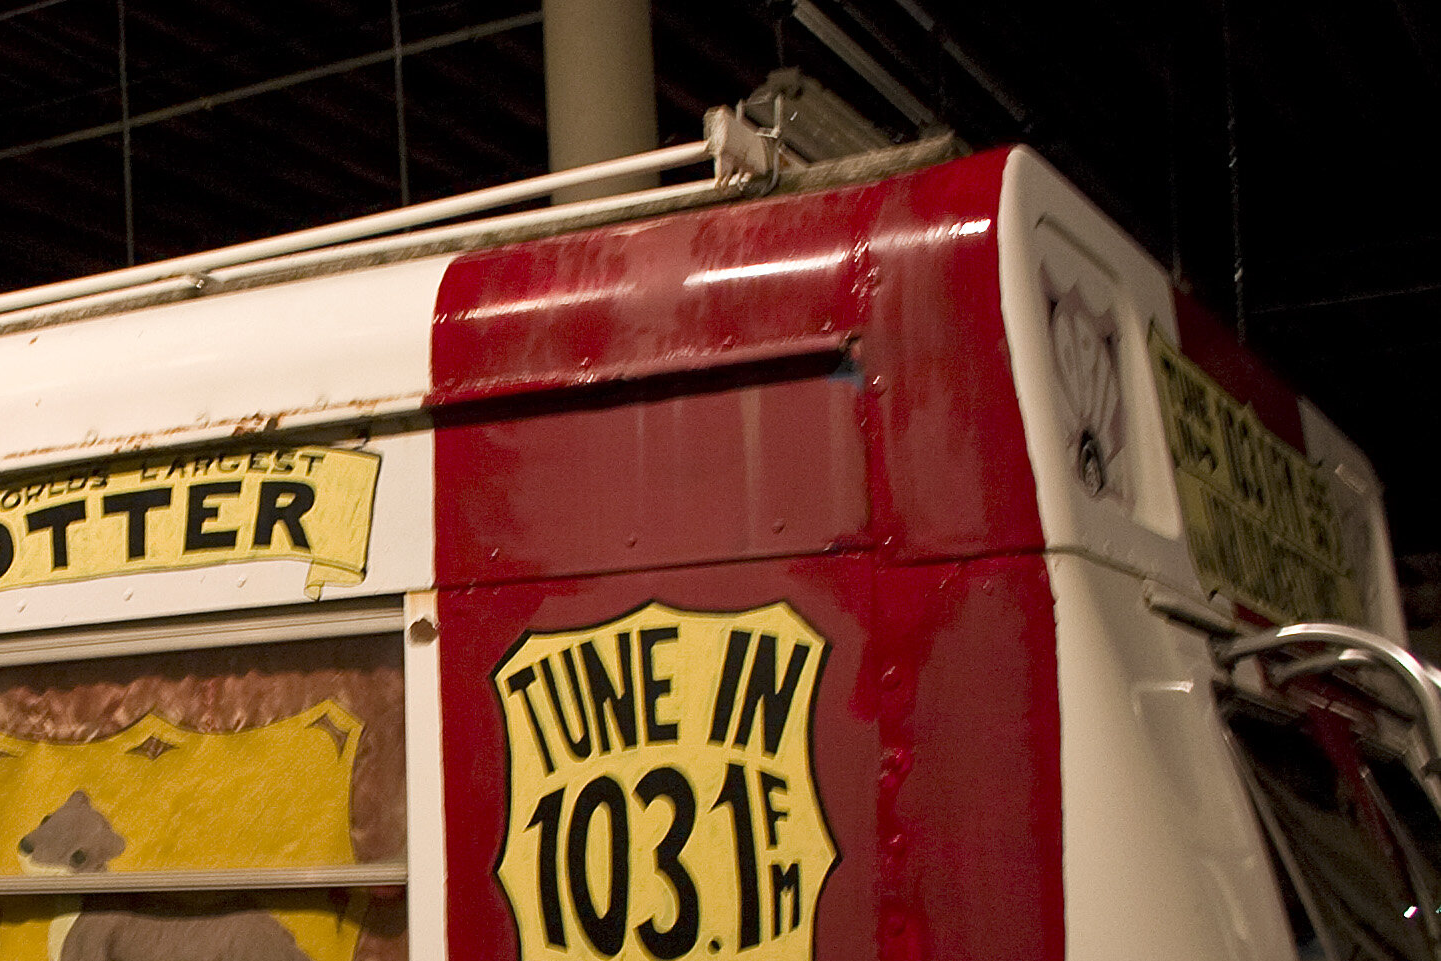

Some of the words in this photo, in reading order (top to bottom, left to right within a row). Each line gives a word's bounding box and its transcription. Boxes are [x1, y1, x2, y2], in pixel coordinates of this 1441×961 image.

[138, 450, 328, 483] LARGEST
[504, 621, 680, 777] TUNE
[707, 624, 810, 761] IN
